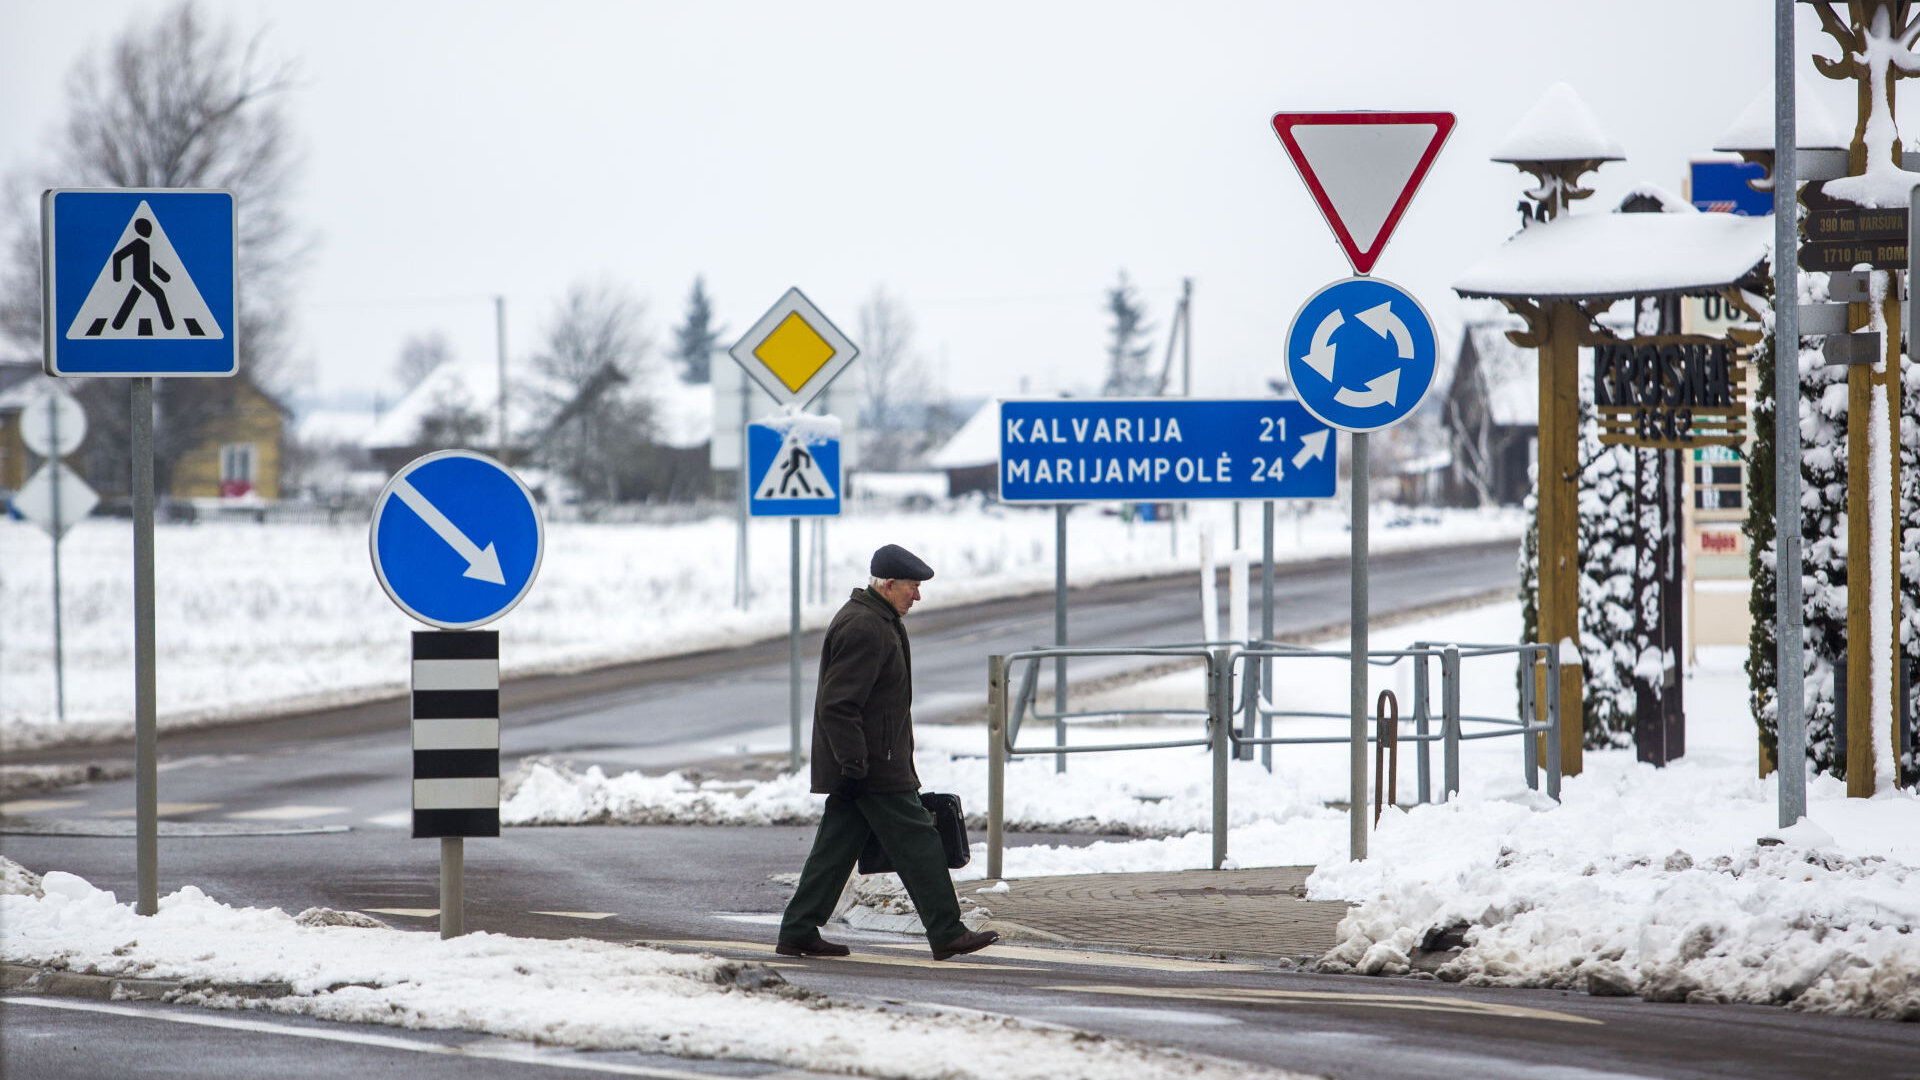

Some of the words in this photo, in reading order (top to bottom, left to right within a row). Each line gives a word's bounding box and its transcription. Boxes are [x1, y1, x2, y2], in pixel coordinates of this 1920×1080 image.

[1820, 217, 1838, 232] 390
[1840, 217, 1855, 232] km
[1823, 248, 1851, 263] 1710
[1854, 248, 1872, 262] km
[1595, 343, 1731, 407] KROSNA
[1007, 417, 1182, 443] KALVARIJA
[1259, 416, 1286, 442] 21
[1007, 451, 1232, 483] MARIJAMPOLĖ
[1251, 457, 1285, 482] 24
